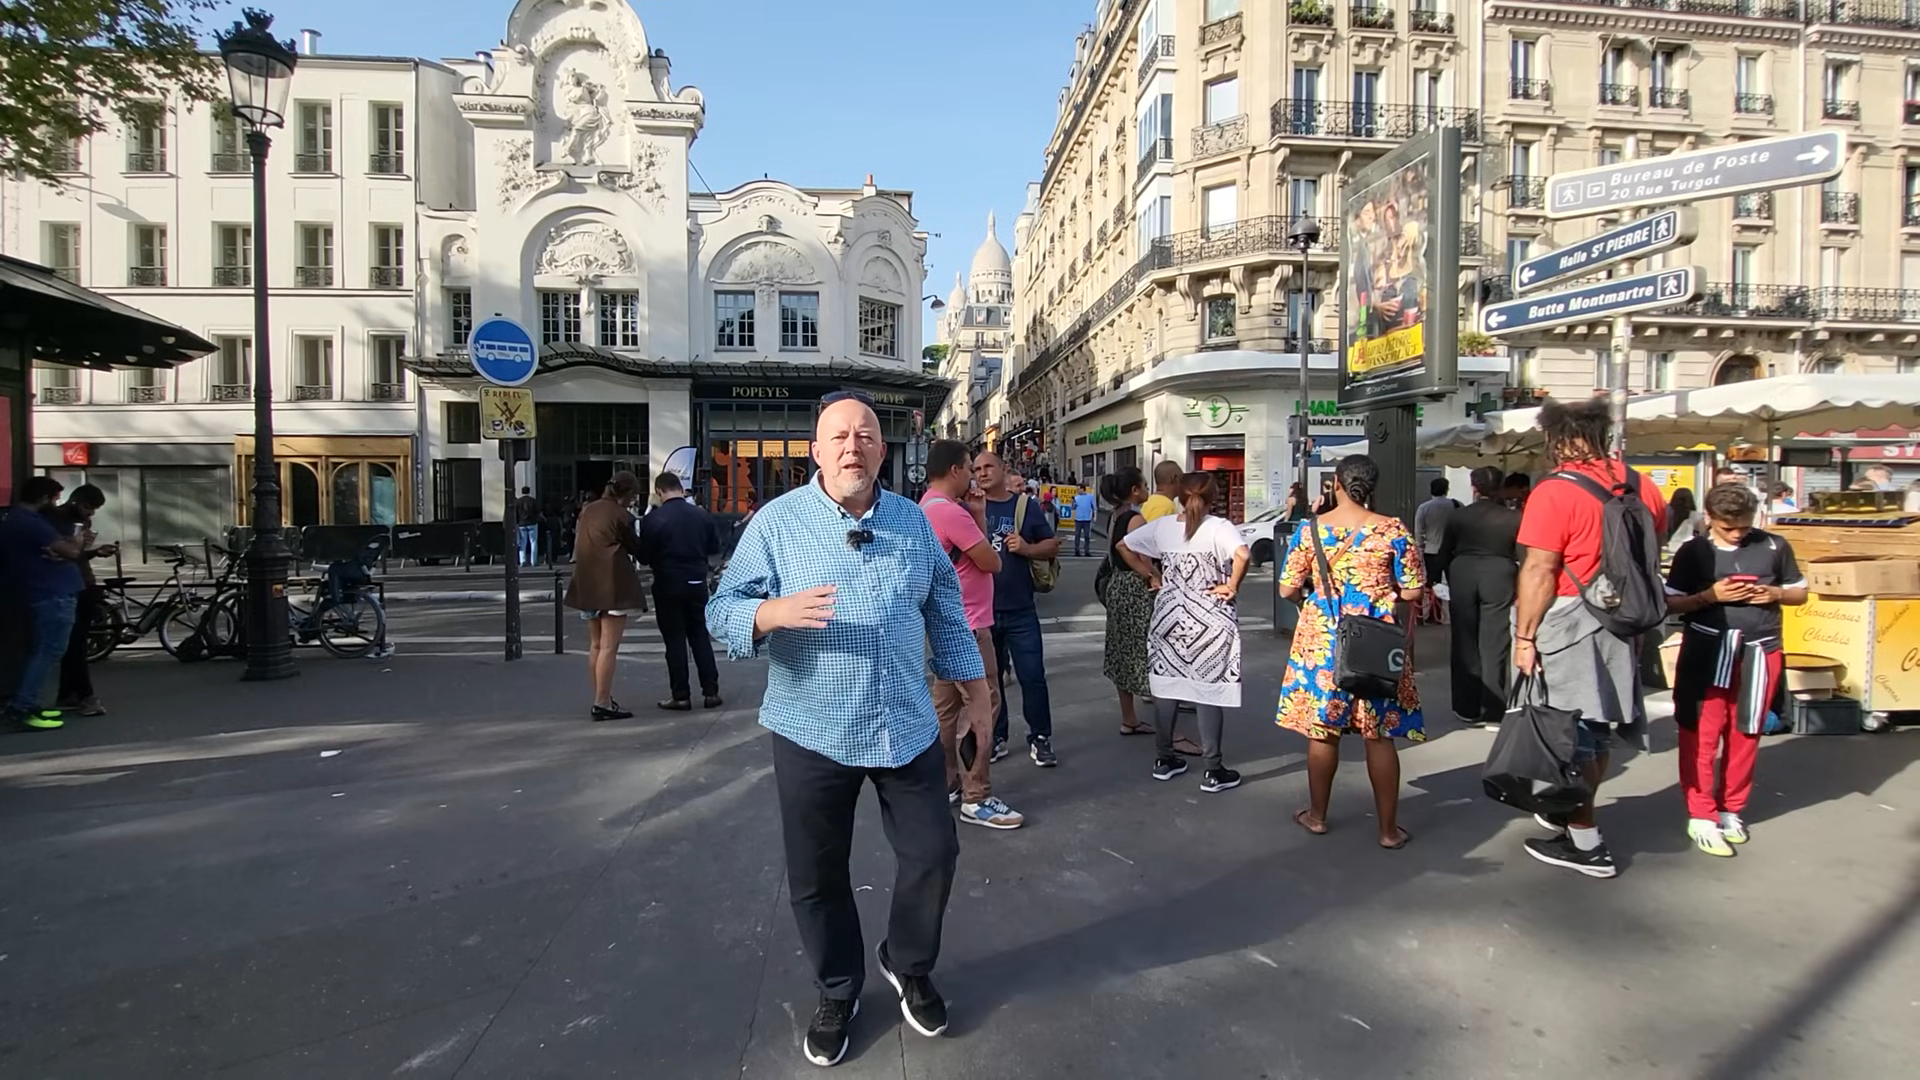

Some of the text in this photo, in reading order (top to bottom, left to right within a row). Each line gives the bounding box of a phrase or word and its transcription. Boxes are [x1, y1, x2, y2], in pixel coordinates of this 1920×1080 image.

[1610, 151, 1770, 186] Bureau de Poste
[1635, 185, 1663, 196] Rue
[1671, 175, 1721, 191] Turgot
[1559, 251, 1587, 269] Halle
[1606, 226, 1651, 254] PIERRE
[1528, 284, 1655, 319] Butte Montmartre
[732, 387, 789, 398] POPEYES
